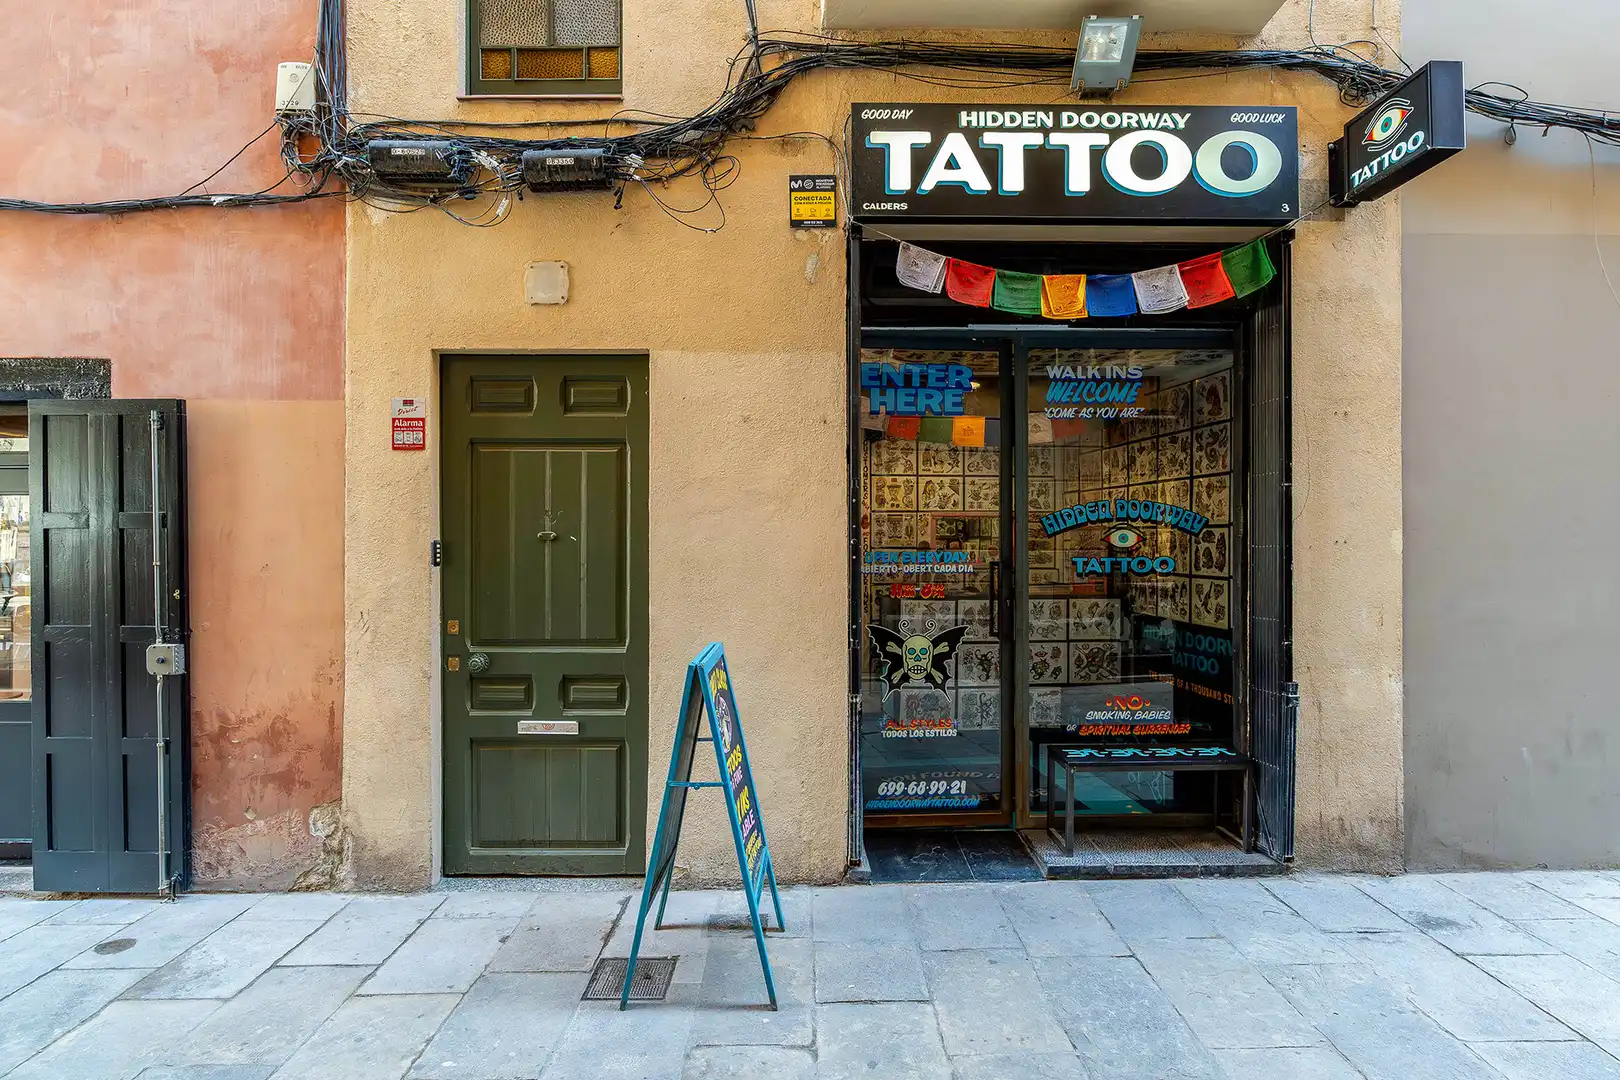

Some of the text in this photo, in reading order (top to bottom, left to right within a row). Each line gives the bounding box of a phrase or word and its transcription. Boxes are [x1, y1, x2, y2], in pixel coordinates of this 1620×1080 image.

[861, 108, 914, 120] GOOD DAY
[959, 110, 1191, 131] HIDDEN DOORWAY
[1230, 112, 1286, 124] GOOD LUCK
[865, 130, 1282, 198] TATTOO
[1350, 130, 1425, 188] TATTOO
[863, 202, 908, 210] CALDERS
[1281, 203, 1290, 213] 3
[861, 363, 974, 391] ENTER
[1046, 365, 1144, 380] WALK INS
[1045, 381, 1143, 404] WELCOME
[870, 387, 964, 416] HERE
[1079, 407, 1095, 419] AS
[1096, 407, 1119, 419] YOU
[394, 419, 423, 427] Alarma
[1040, 499, 1209, 538] HIDDEN DOORWAY
[865, 551, 899, 564] OPEN
[934, 564, 957, 573] CADA
[958, 564, 974, 573] DIA
[1071, 556, 1176, 576] TATTOO
[1172, 652, 1219, 674] TATTOO
[1113, 694, 1143, 710] NO
[1085, 710, 1171, 721] SMOKING, BABIES
[885, 718, 952, 730] ALL STYLES
[1066, 723, 1191, 736] OR SPIRITUAL SURRENDER
[881, 729, 957, 738] TODOS LOS ESTILOS
[919, 771, 984, 779] FOUND
[866, 798, 980, 810] HIDDENDOORWAYTATTOO.COM
